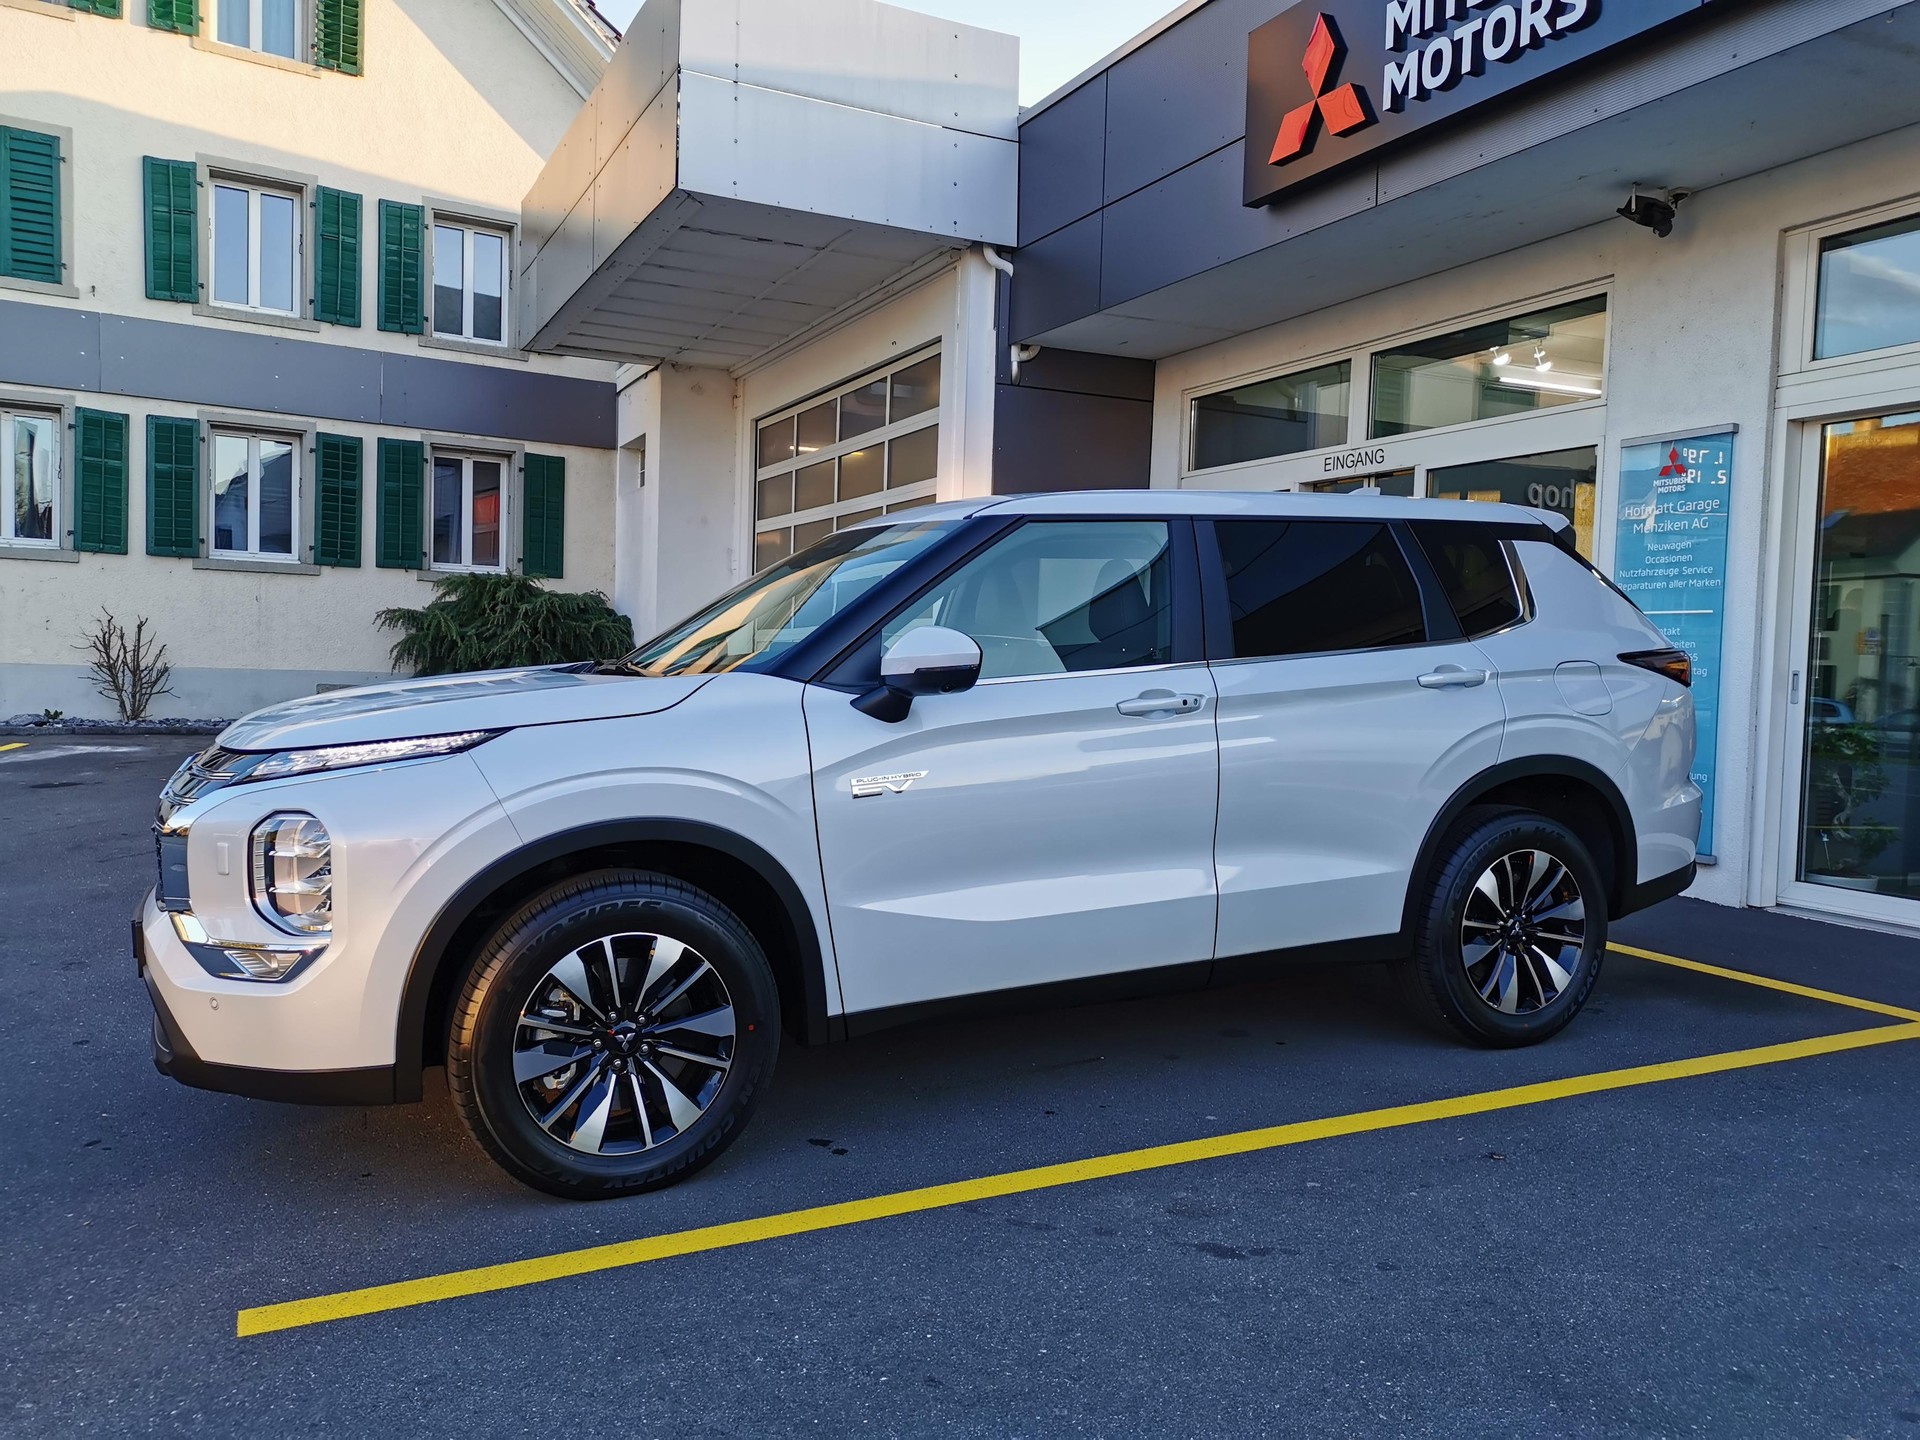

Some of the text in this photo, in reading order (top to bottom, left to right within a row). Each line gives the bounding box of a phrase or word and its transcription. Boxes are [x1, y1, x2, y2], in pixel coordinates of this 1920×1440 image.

[1382, 0, 1588, 112] MOTORS
[1324, 448, 1385, 472] EINGANG
[1658, 484, 1686, 493] MOTORS
[1625, 499, 1720, 517] Hofmatt Garage
[1633, 517, 1709, 534] Menziken AG
[1647, 541, 1692, 551] Neuwagen
[1645, 554, 1693, 564] Occasionen
[1619, 565, 1714, 578] Nutzfahrzeuge Service
[1617, 578, 1721, 592] Reparaturen aller Marken
[856, 771, 922, 784] PLUG-IN HYBRID
[567, 900, 664, 923] TIRES
